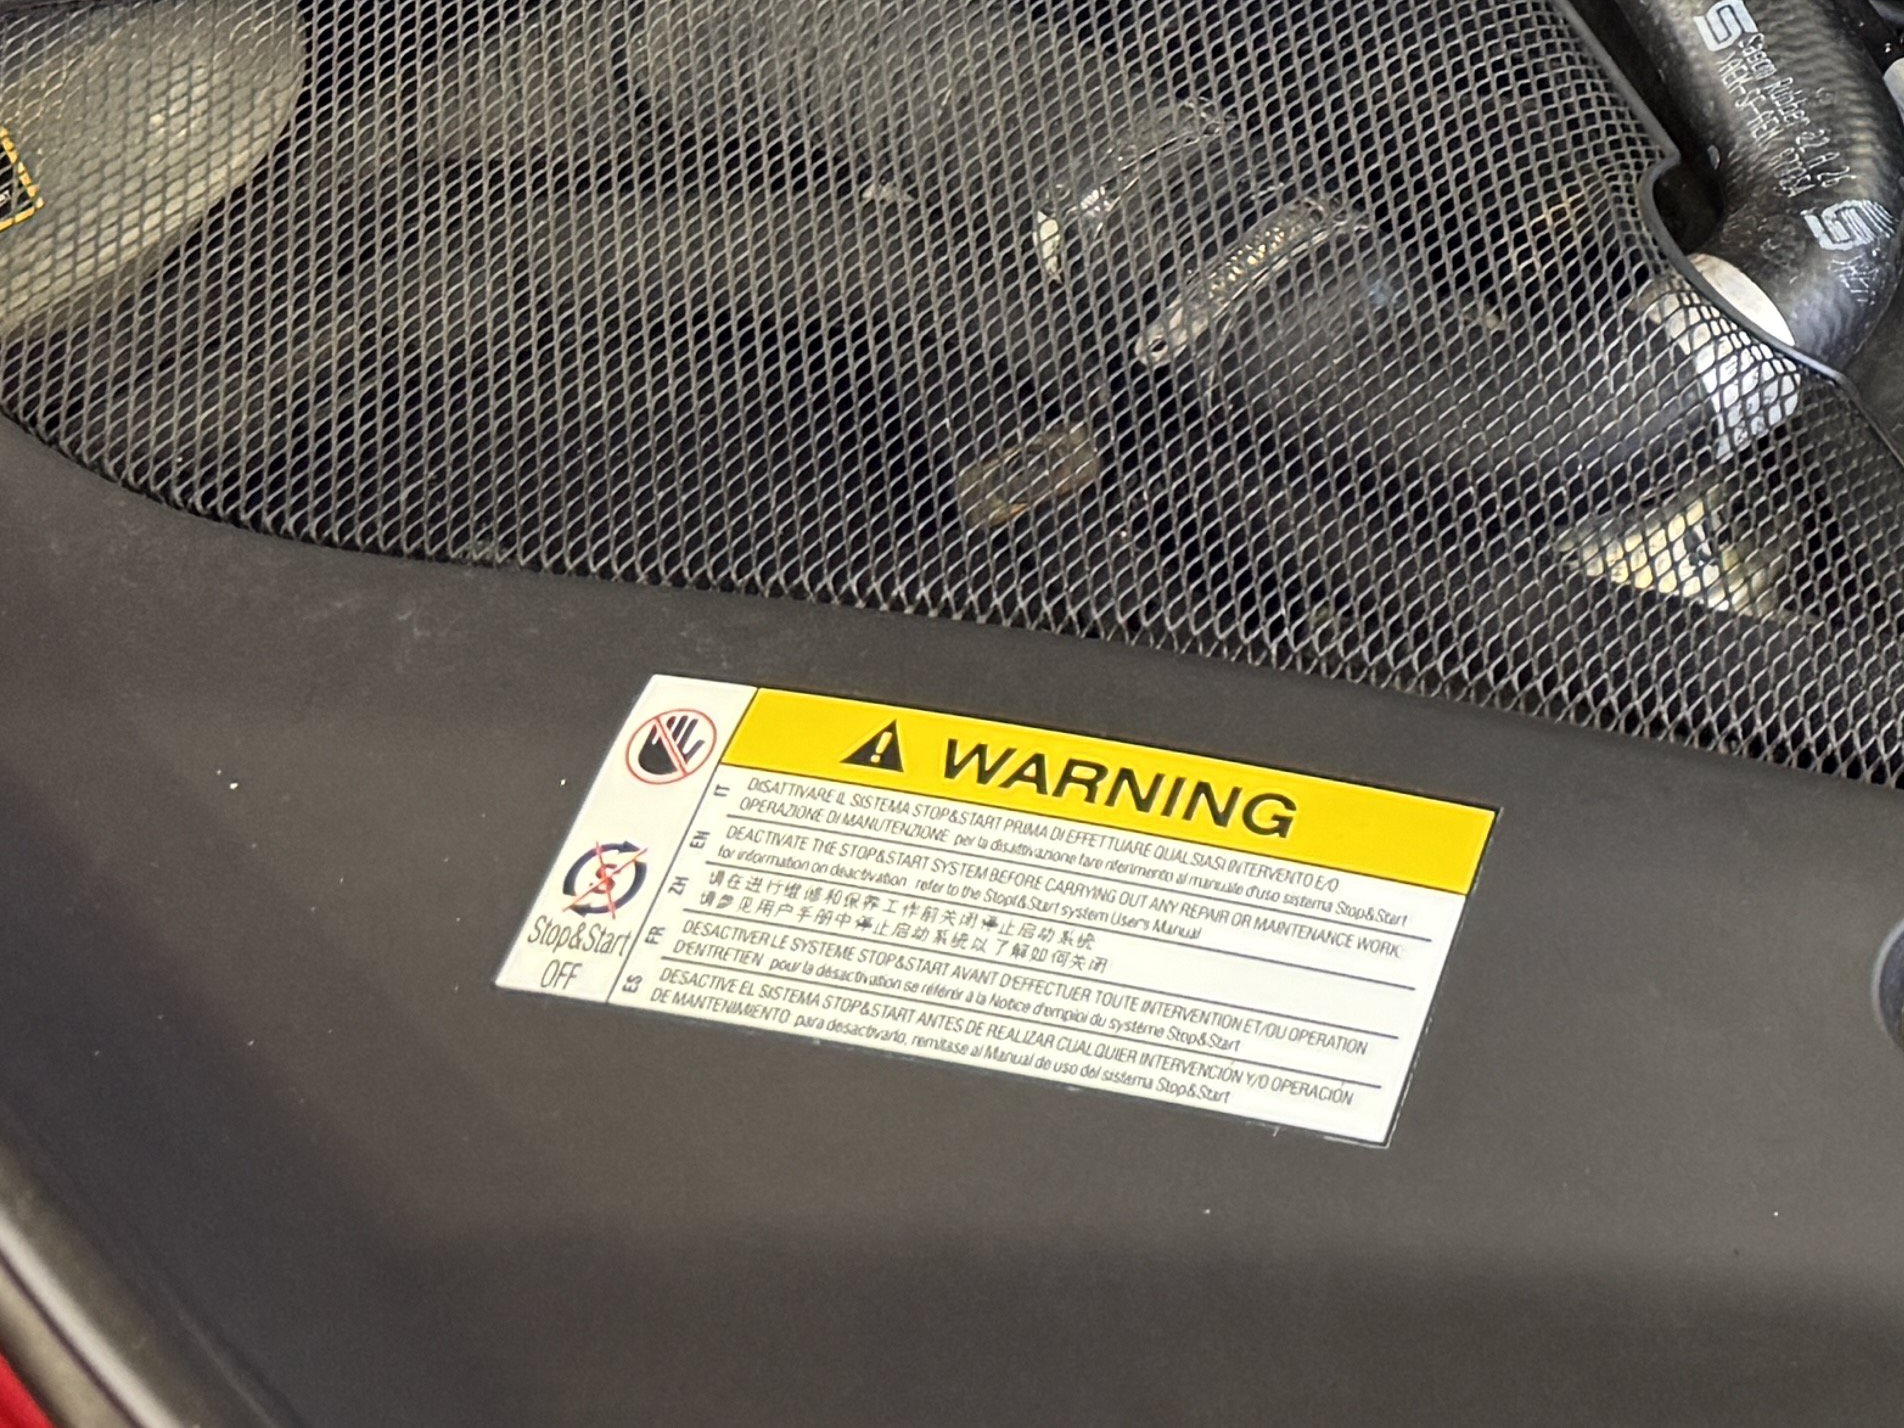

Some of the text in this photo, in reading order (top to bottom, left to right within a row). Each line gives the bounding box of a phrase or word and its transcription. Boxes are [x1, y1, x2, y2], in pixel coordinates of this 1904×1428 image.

[1764, 76, 1811, 127] Rubber
[945, 740, 1294, 836] WARNING
[739, 796, 823, 823] OPERAZIONE
[841, 813, 948, 842] MANUTENZIONE
[849, 793, 910, 814] SISTEMA
[912, 803, 1002, 829] STOP&START
[1002, 818, 1048, 838] PRIMA
[1065, 829, 1152, 858] EFFETTUARE
[725, 825, 1353, 948] DEACTIVATE THE STOP&START SYSTEM BEFORE CARRYING OUT ANY REPAIR OR MAINTENANCE
[527, 915, 631, 956] Stop&Start
[539, 958, 583, 990] OFF
[682, 919, 1368, 1055] DESACTIVER LE SYSTEME STOP&START AVANT TOUTE INTERVENTION ET/OU OPERATION
[649, 986, 671, 1004] DE
[671, 991, 791, 1024] MANTENIMIENTO
[658, 967, 1354, 1105] DESACTIVE EL SISTEMA STOP&START ANTES DE REALIZAR CUALQUIER INTERVENCIÓN Y/O OPERACIÓN
